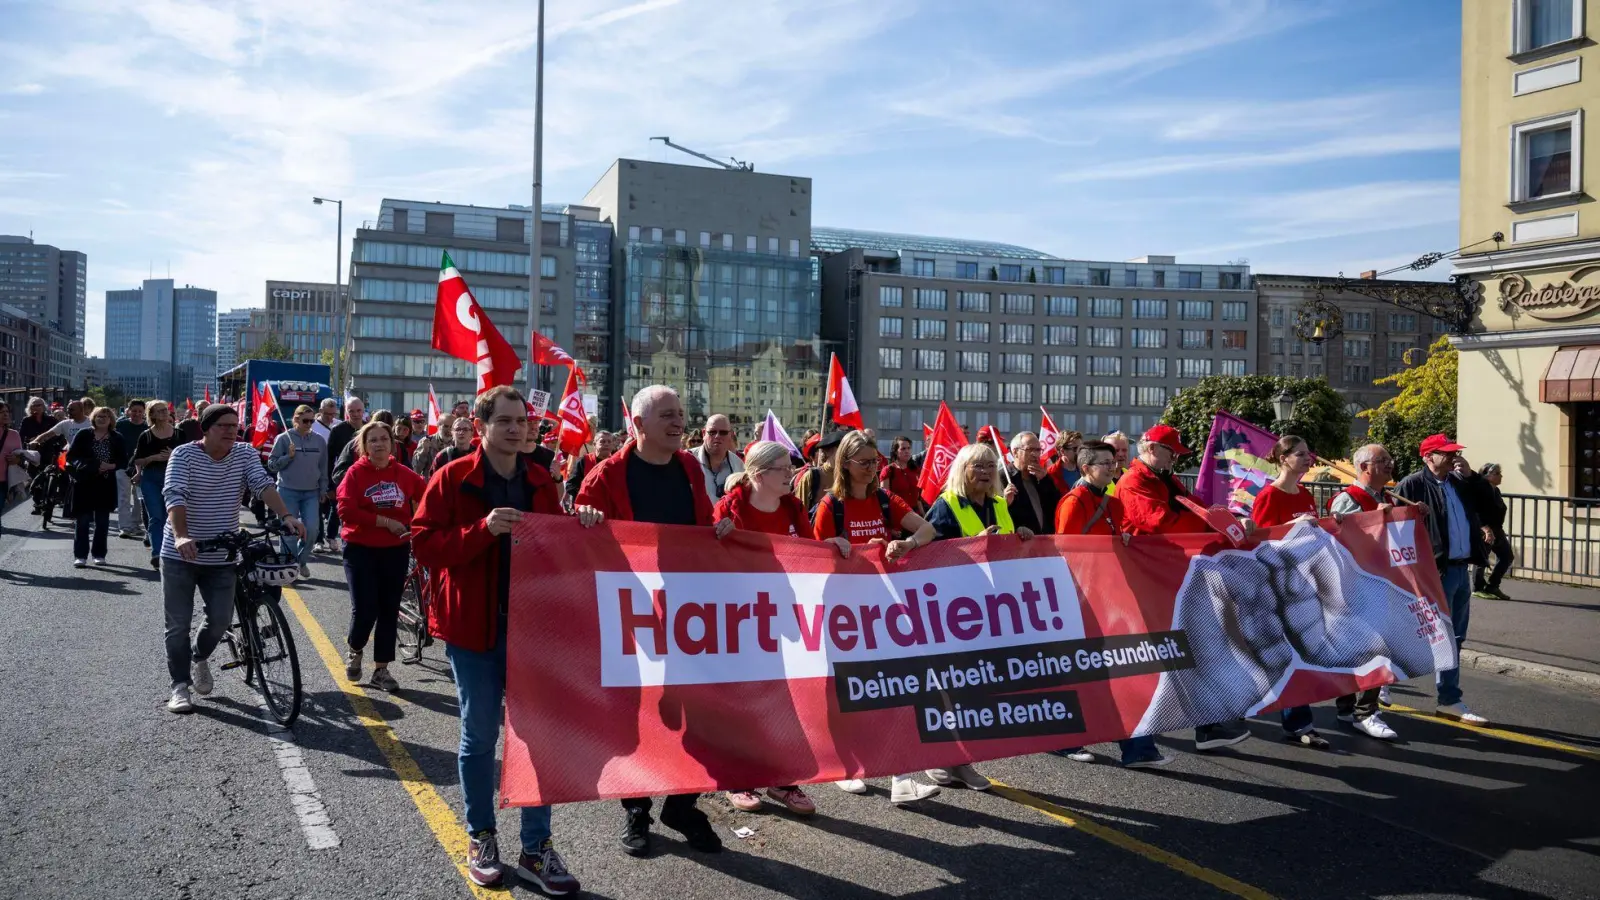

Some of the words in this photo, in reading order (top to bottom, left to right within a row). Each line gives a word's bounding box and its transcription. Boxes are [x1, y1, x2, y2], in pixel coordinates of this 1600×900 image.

[273, 289, 311, 300] capri
[1391, 547, 1416, 562] DGB
[618, 588, 778, 655] Hart
[792, 577, 1063, 651] verdient!
[1416, 606, 1440, 626] DICH
[1416, 623, 1438, 639] STARK
[847, 671, 919, 701] Deine
[925, 659, 1004, 692] Arbeit.
[1007, 652, 1072, 681] Deine
[1075, 637, 1186, 671] Gesundheit.
[924, 703, 994, 732] Deine
[998, 699, 1073, 725] Rente.
